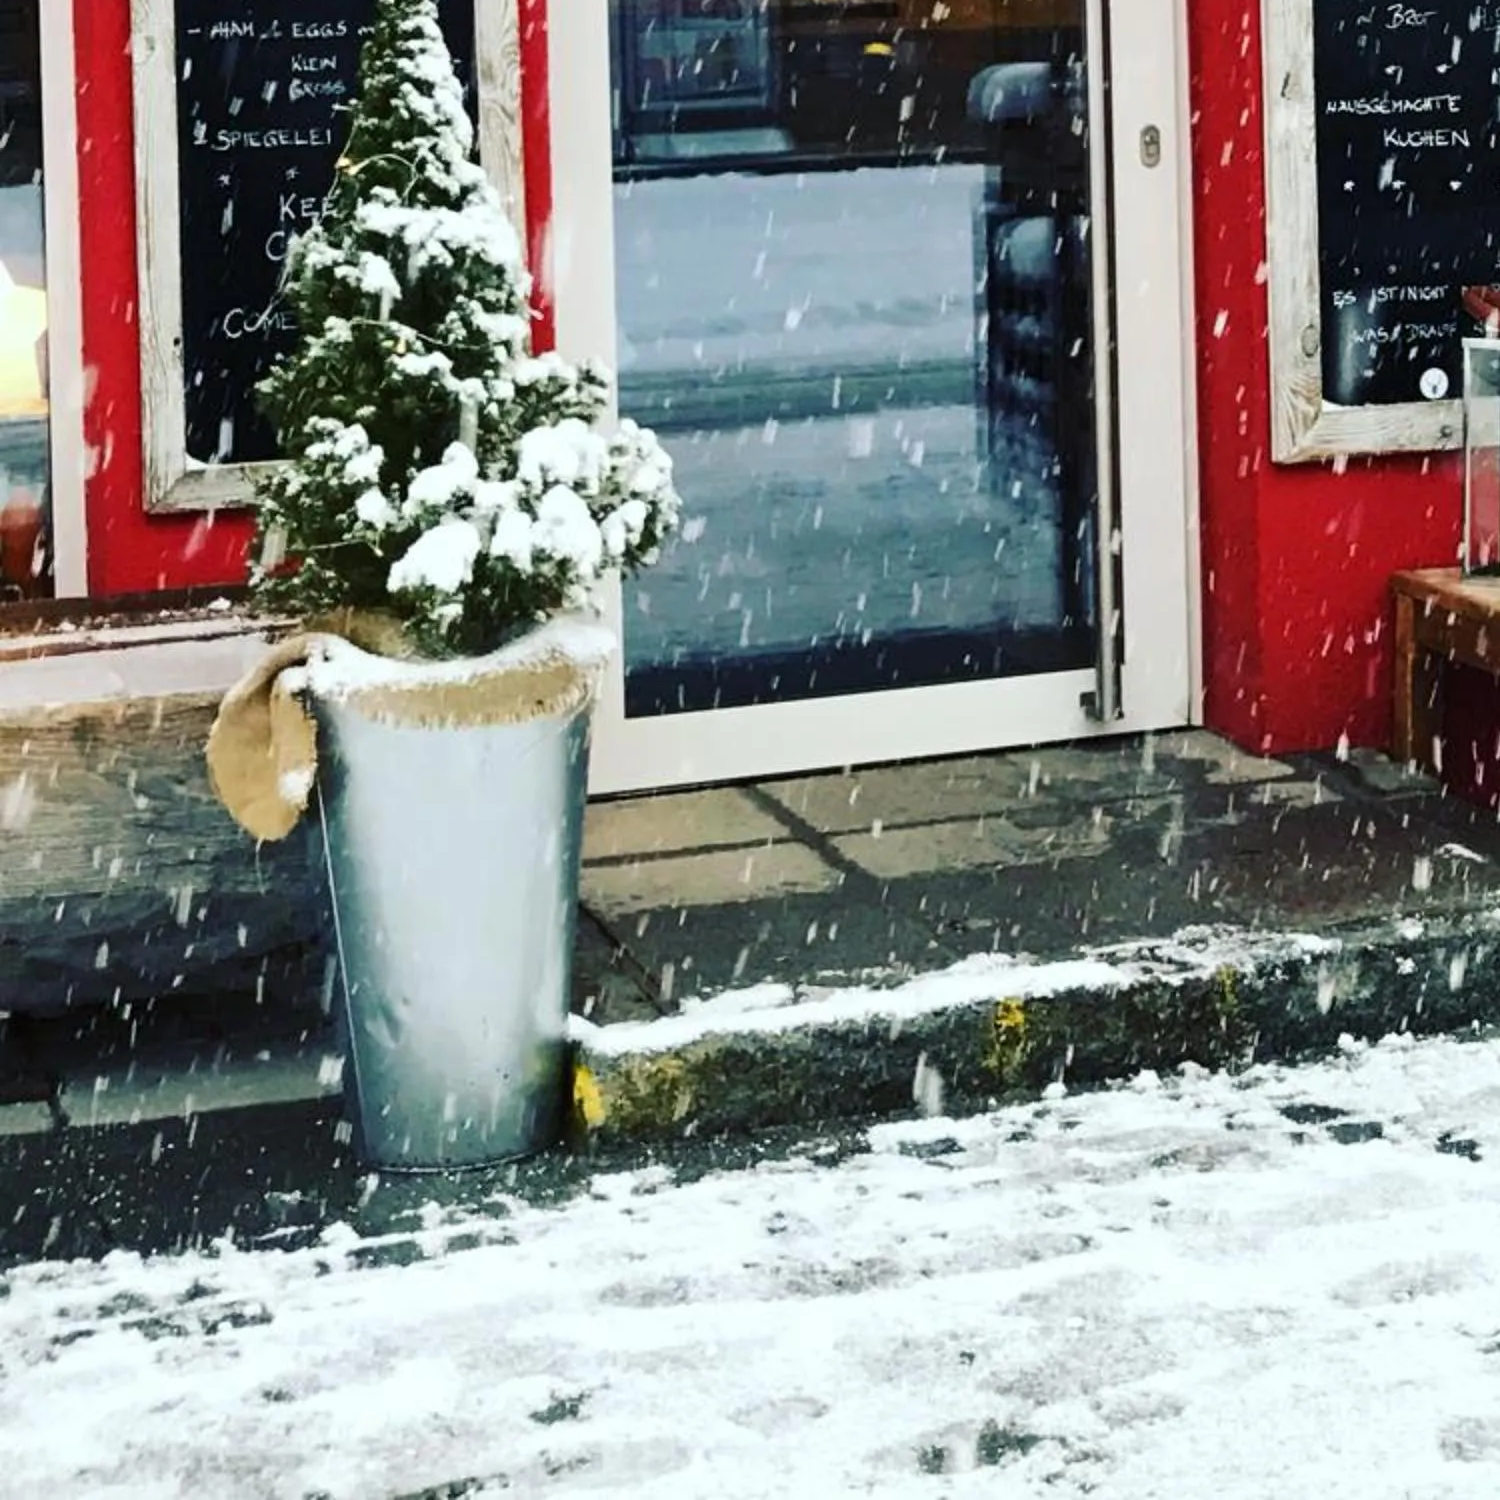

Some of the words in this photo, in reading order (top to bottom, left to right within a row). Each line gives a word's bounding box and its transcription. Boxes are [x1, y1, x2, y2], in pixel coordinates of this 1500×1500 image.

[291, 21, 347, 39] EGGS
[1383, 129, 1470, 147] KUCHEN
[279, 193, 337, 221] KEE
